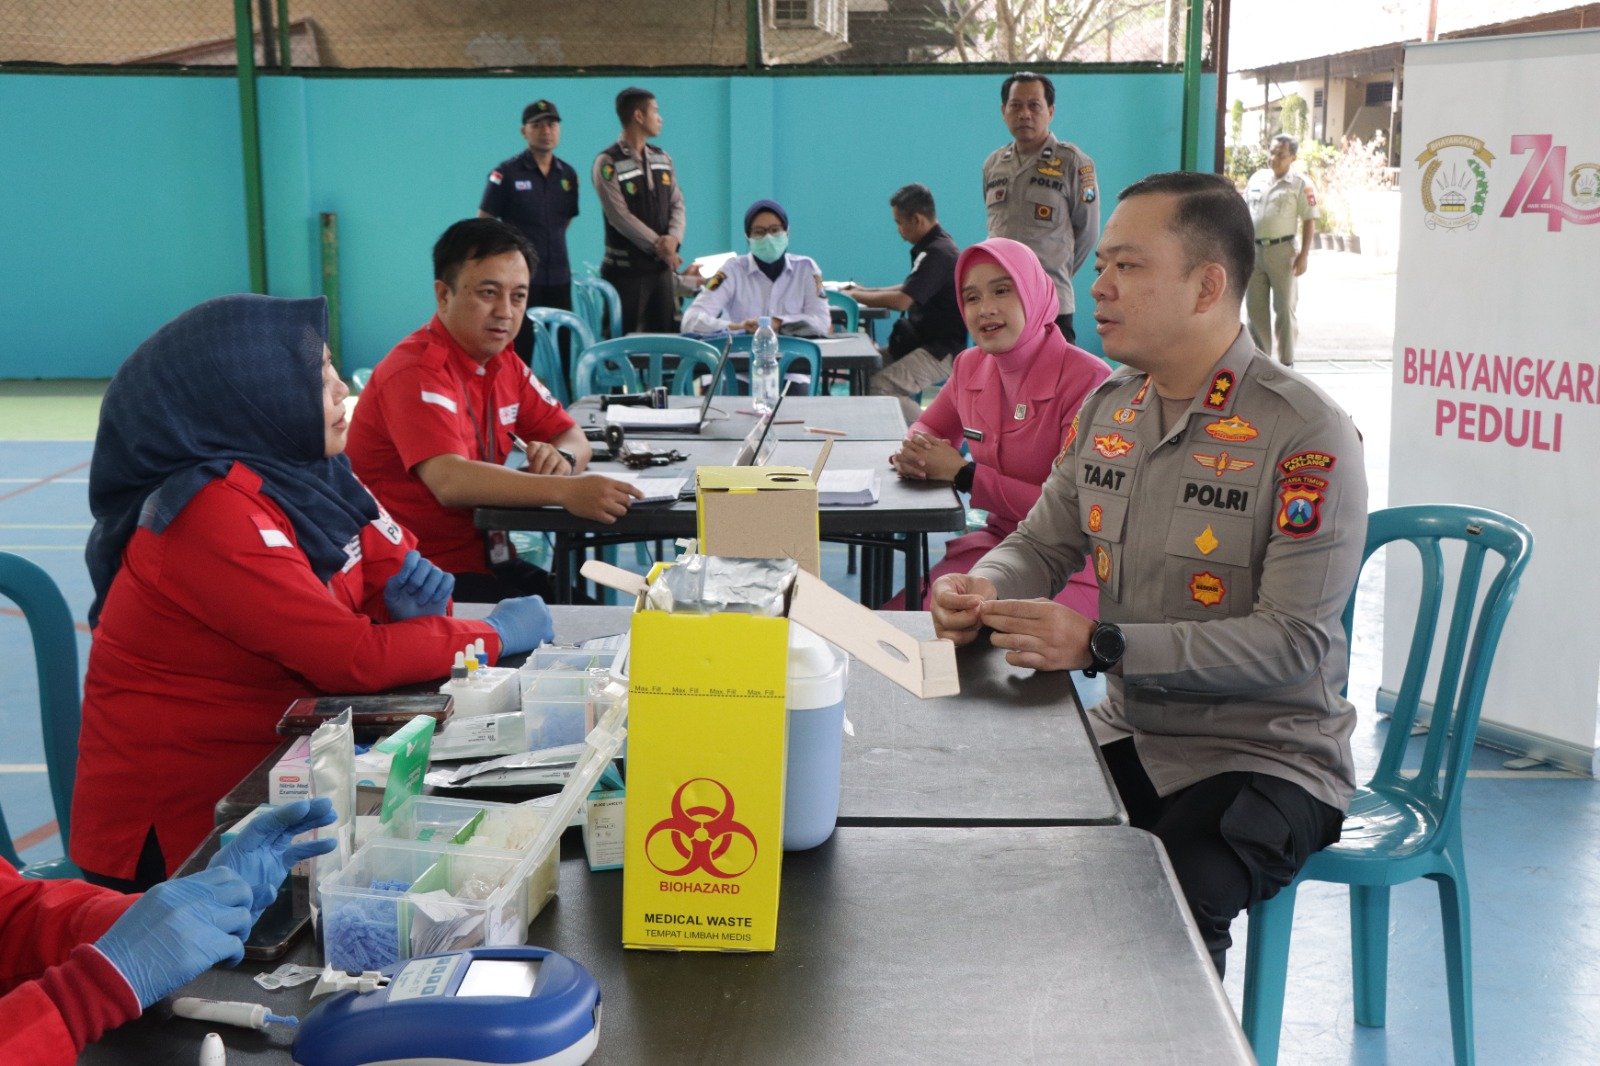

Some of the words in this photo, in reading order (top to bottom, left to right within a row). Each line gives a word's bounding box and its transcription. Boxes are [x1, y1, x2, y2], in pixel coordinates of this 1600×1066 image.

[1029, 177, 1064, 191] POLRI
[1500, 134, 1567, 232] 74
[1435, 399, 1563, 453] PEDULI
[1283, 453, 1331, 469] POLRES
[1288, 459, 1326, 471] MALANG
[1084, 463, 1126, 491] TAAT
[1303, 477, 1325, 488] TIMUR
[1183, 482, 1249, 512] POLRI
[652, 685, 662, 693] Fill
[727, 688, 737, 696] Fill
[660, 881, 740, 895] BIOHAZARD
[644, 913, 703, 926] MEDICAL
[707, 916, 753, 928] WASTE
[645, 929, 682, 938] TEMPAT
[684, 931, 719, 940] LIMBAH
[721, 933, 752, 942] MEDIS
